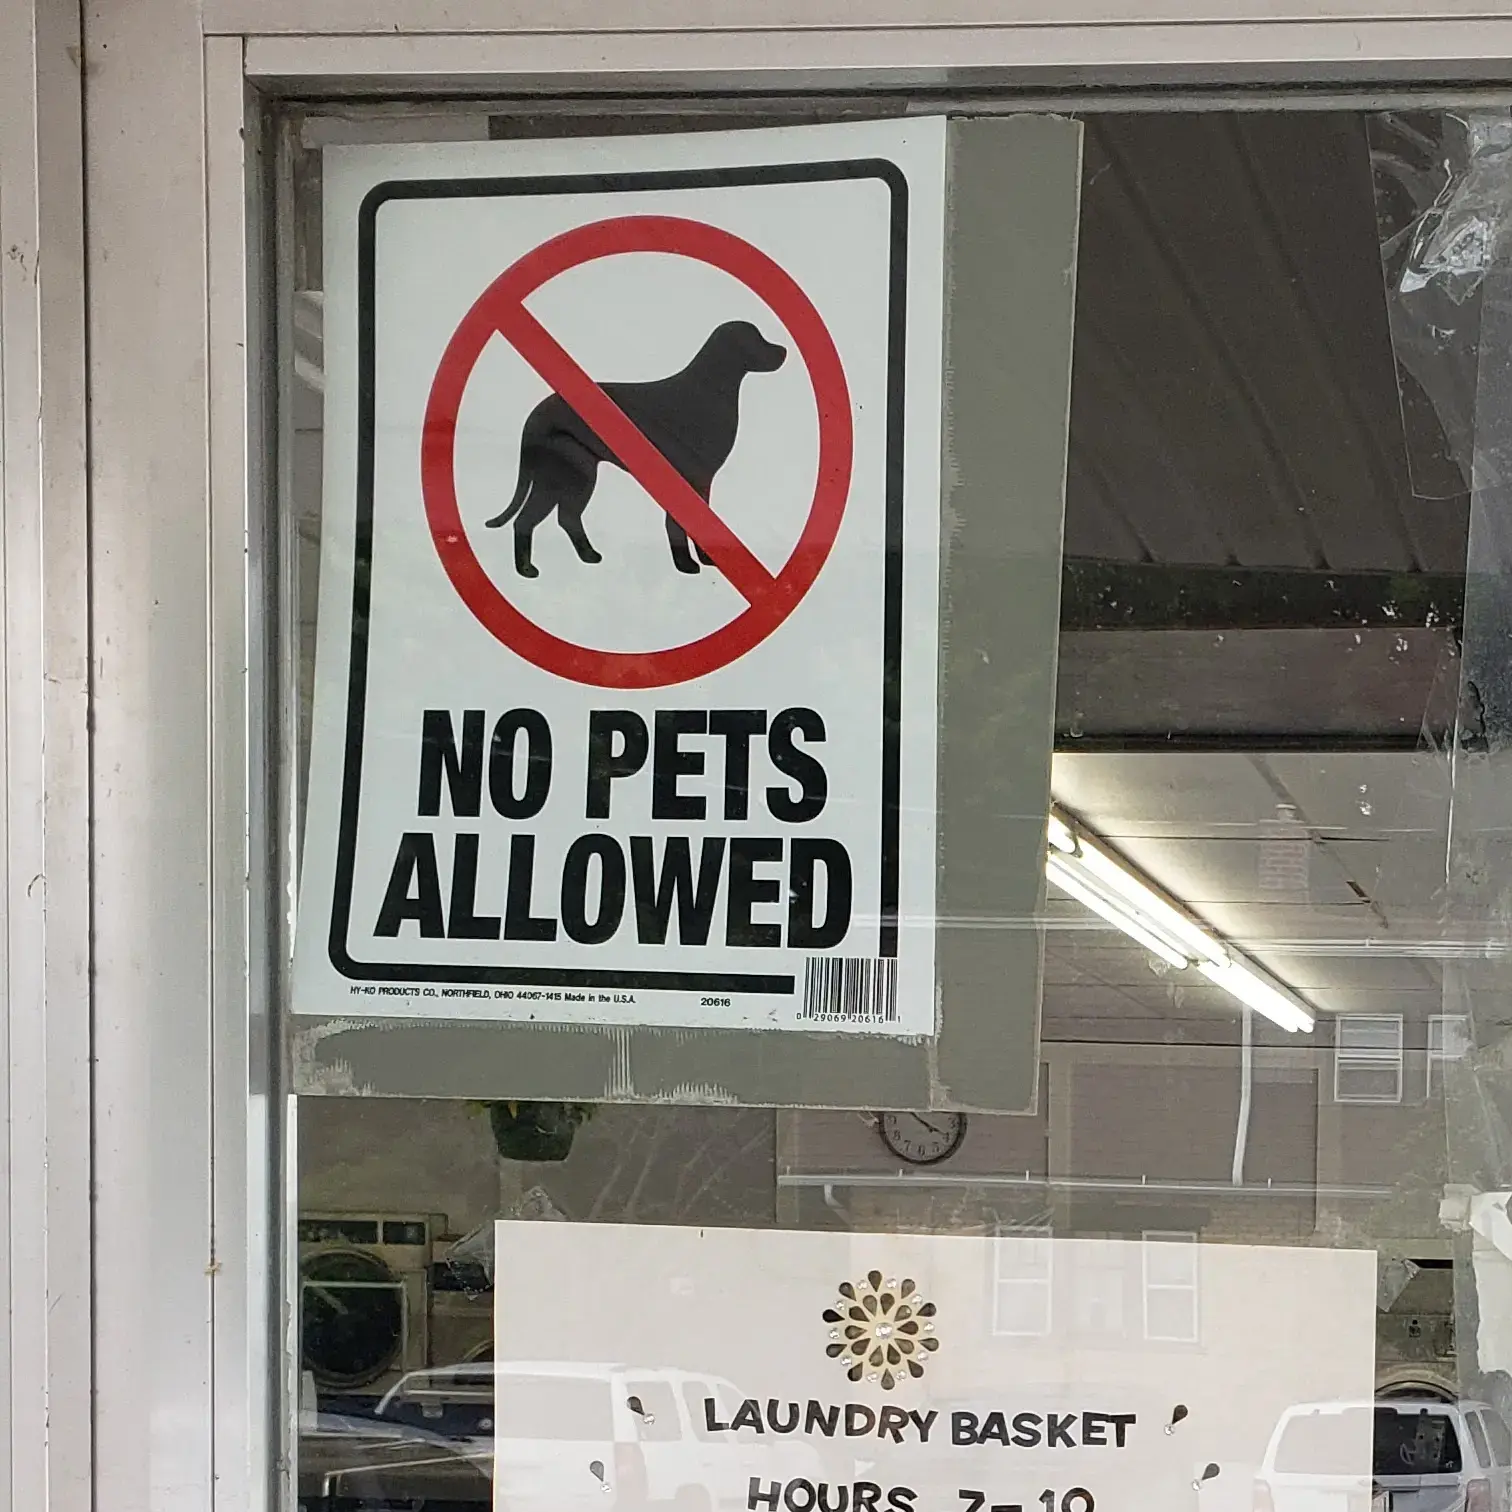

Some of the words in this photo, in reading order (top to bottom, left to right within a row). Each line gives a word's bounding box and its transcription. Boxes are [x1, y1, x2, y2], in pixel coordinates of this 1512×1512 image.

[418, 708, 552, 819] NO
[586, 708, 827, 823] PETS
[373, 833, 852, 948] ALLOWED
[350, 986, 375, 995] HY-KO
[378, 986, 420, 996] PRODUCTS
[441, 989, 492, 1000] NORTHFIELD,
[494, 990, 514, 999] OHIO
[564, 992, 585, 1001] Made
[588, 993, 595, 1002] in
[599, 994, 611, 1002] the
[700, 997, 731, 1007] 20616
[813, 1013, 847, 1022] 29069
[851, 1015, 884, 1024] 20616
[703, 1397, 935, 1444] LAUNDRY
[952, 1412, 1136, 1448] BASKET
